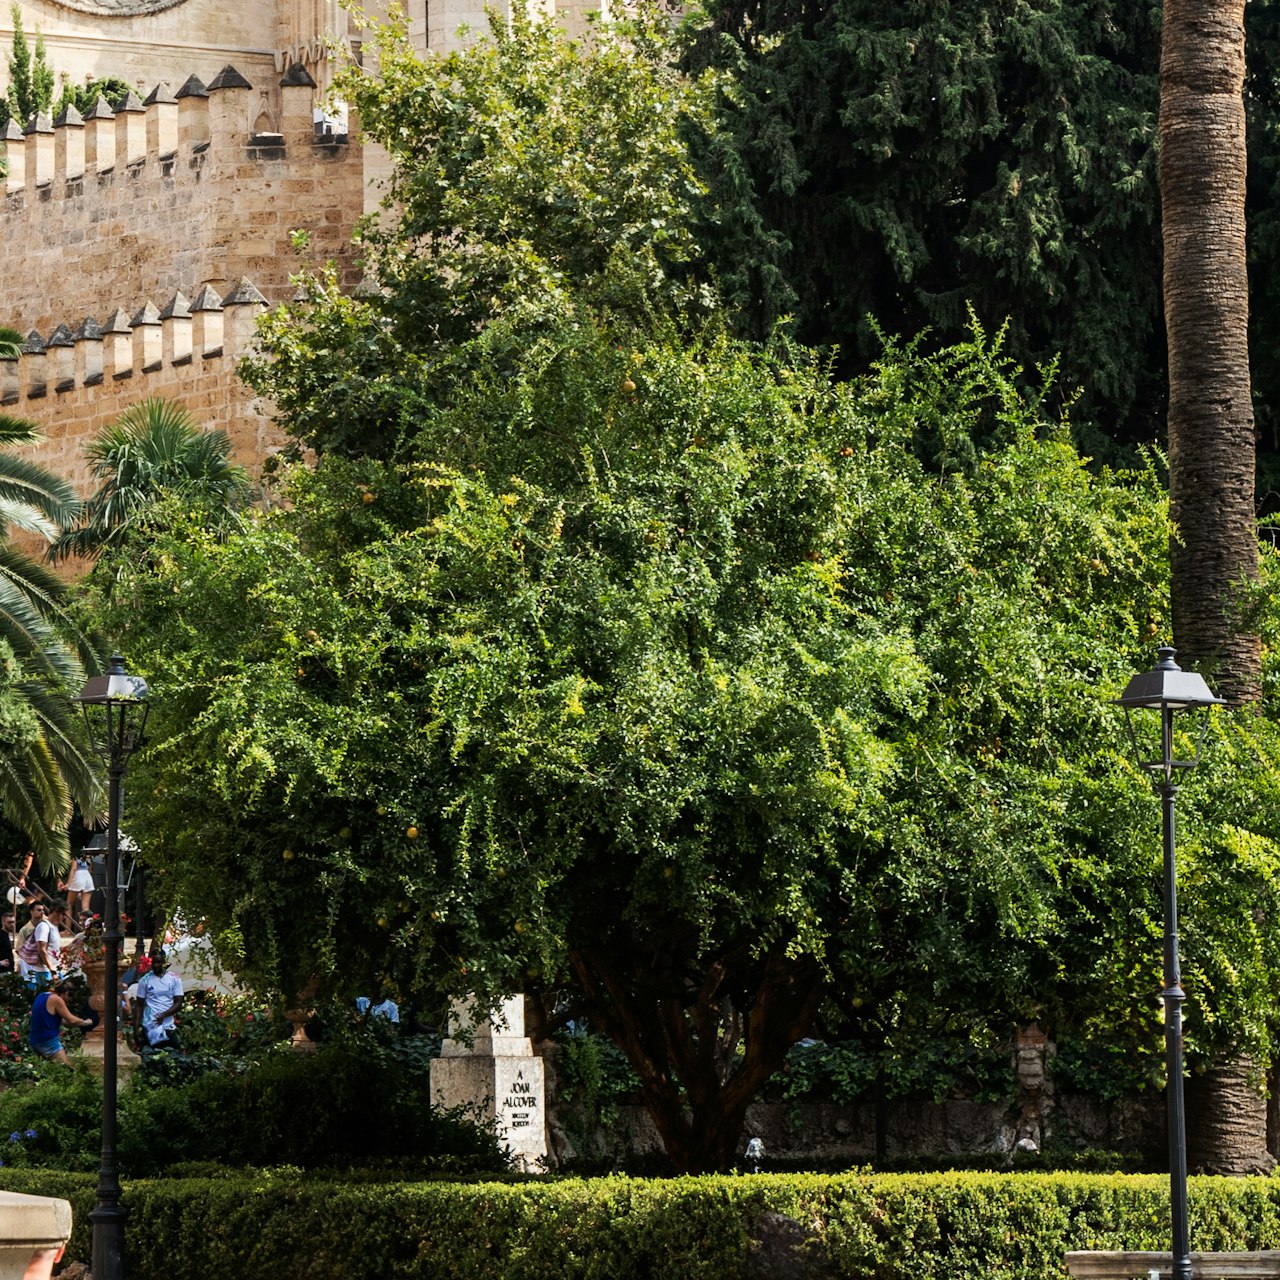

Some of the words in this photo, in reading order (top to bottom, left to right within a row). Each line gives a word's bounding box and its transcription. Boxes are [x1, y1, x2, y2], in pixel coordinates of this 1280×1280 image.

[517, 1070, 523, 1080] A
[510, 1082, 530, 1093] JOAN
[503, 1096, 537, 1107] ALCOVER
